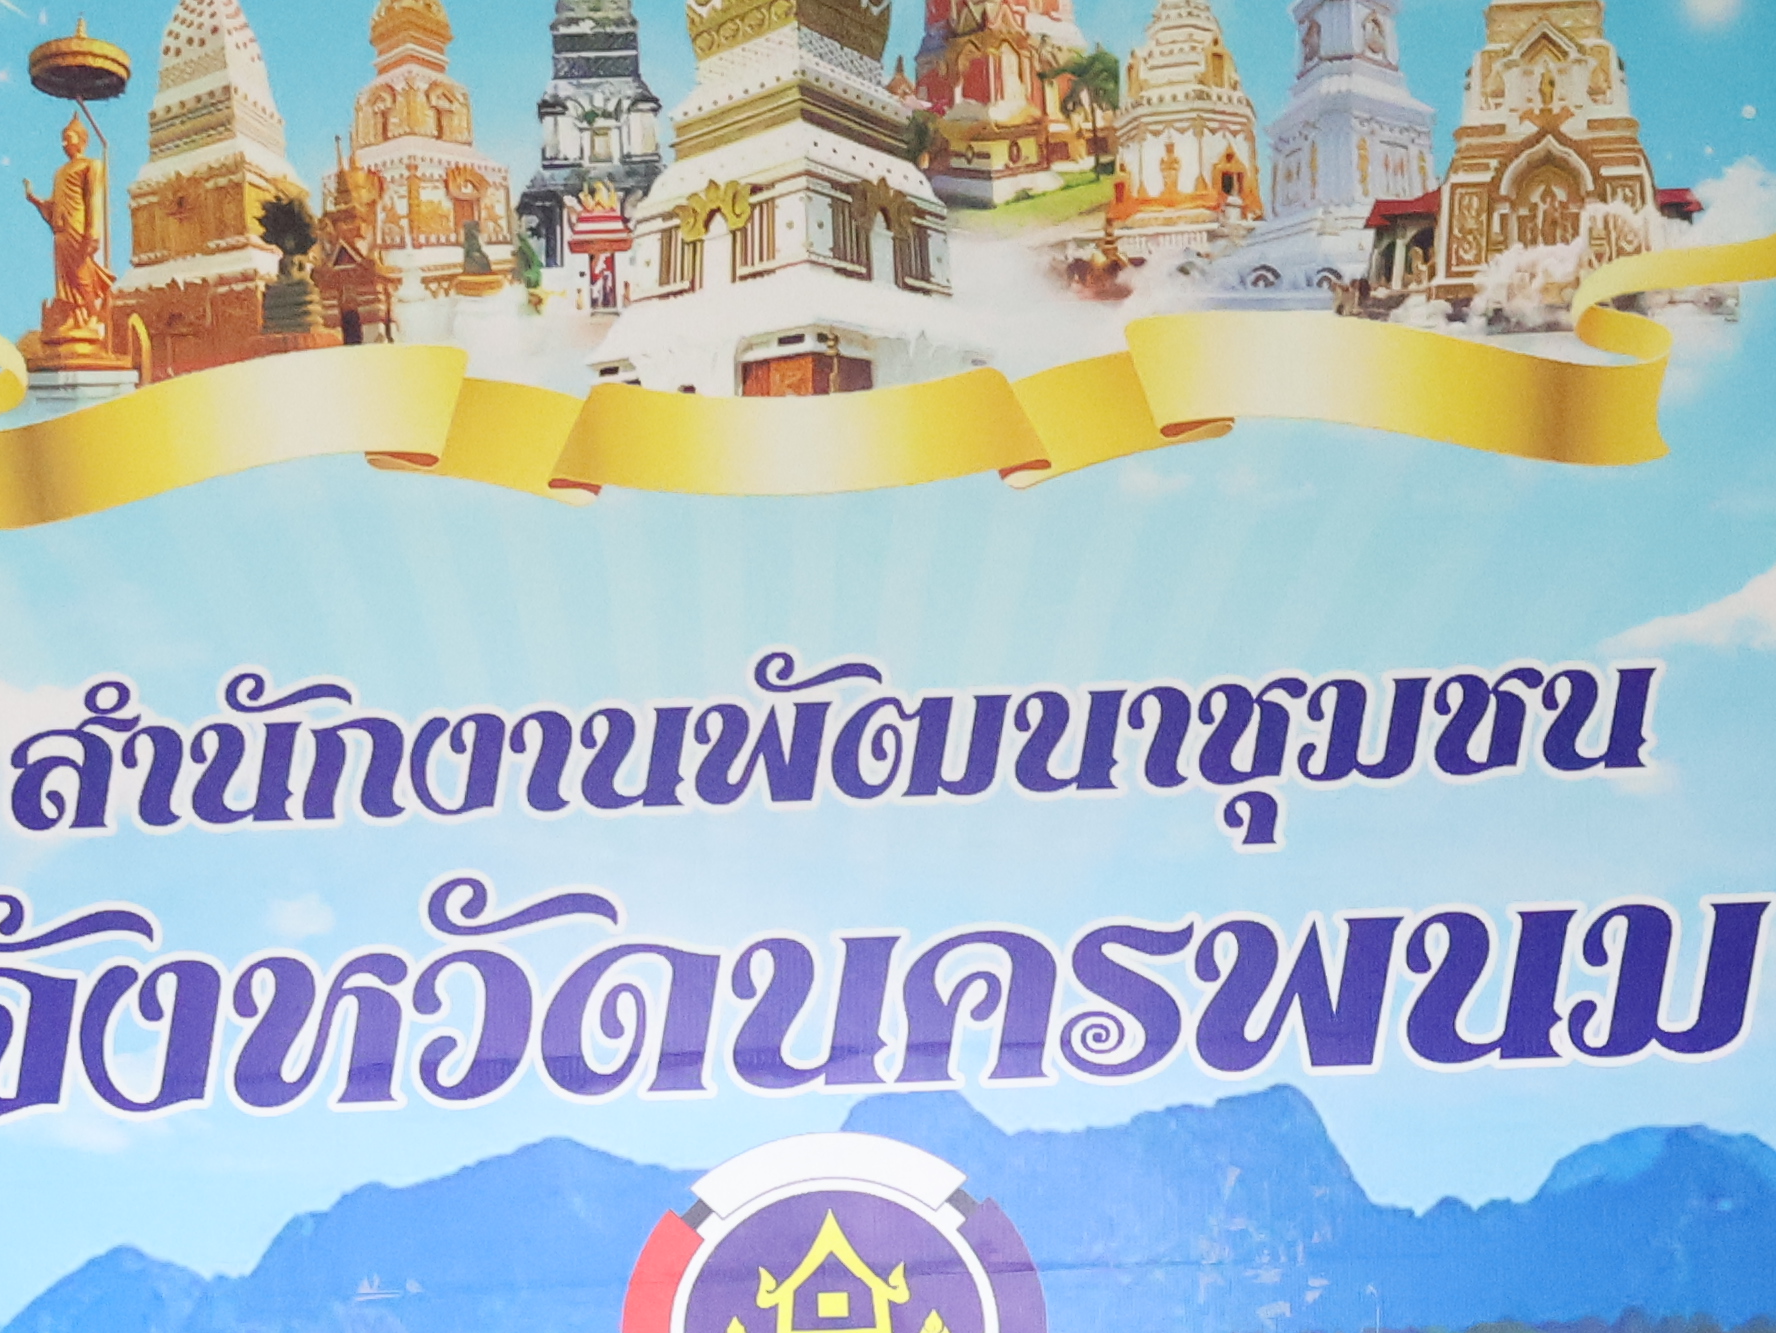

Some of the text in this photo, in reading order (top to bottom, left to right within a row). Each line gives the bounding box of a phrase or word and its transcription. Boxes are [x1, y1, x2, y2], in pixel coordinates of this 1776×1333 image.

[10, 651, 1655, 845] สำนักงานพัฒนาชุมชน
